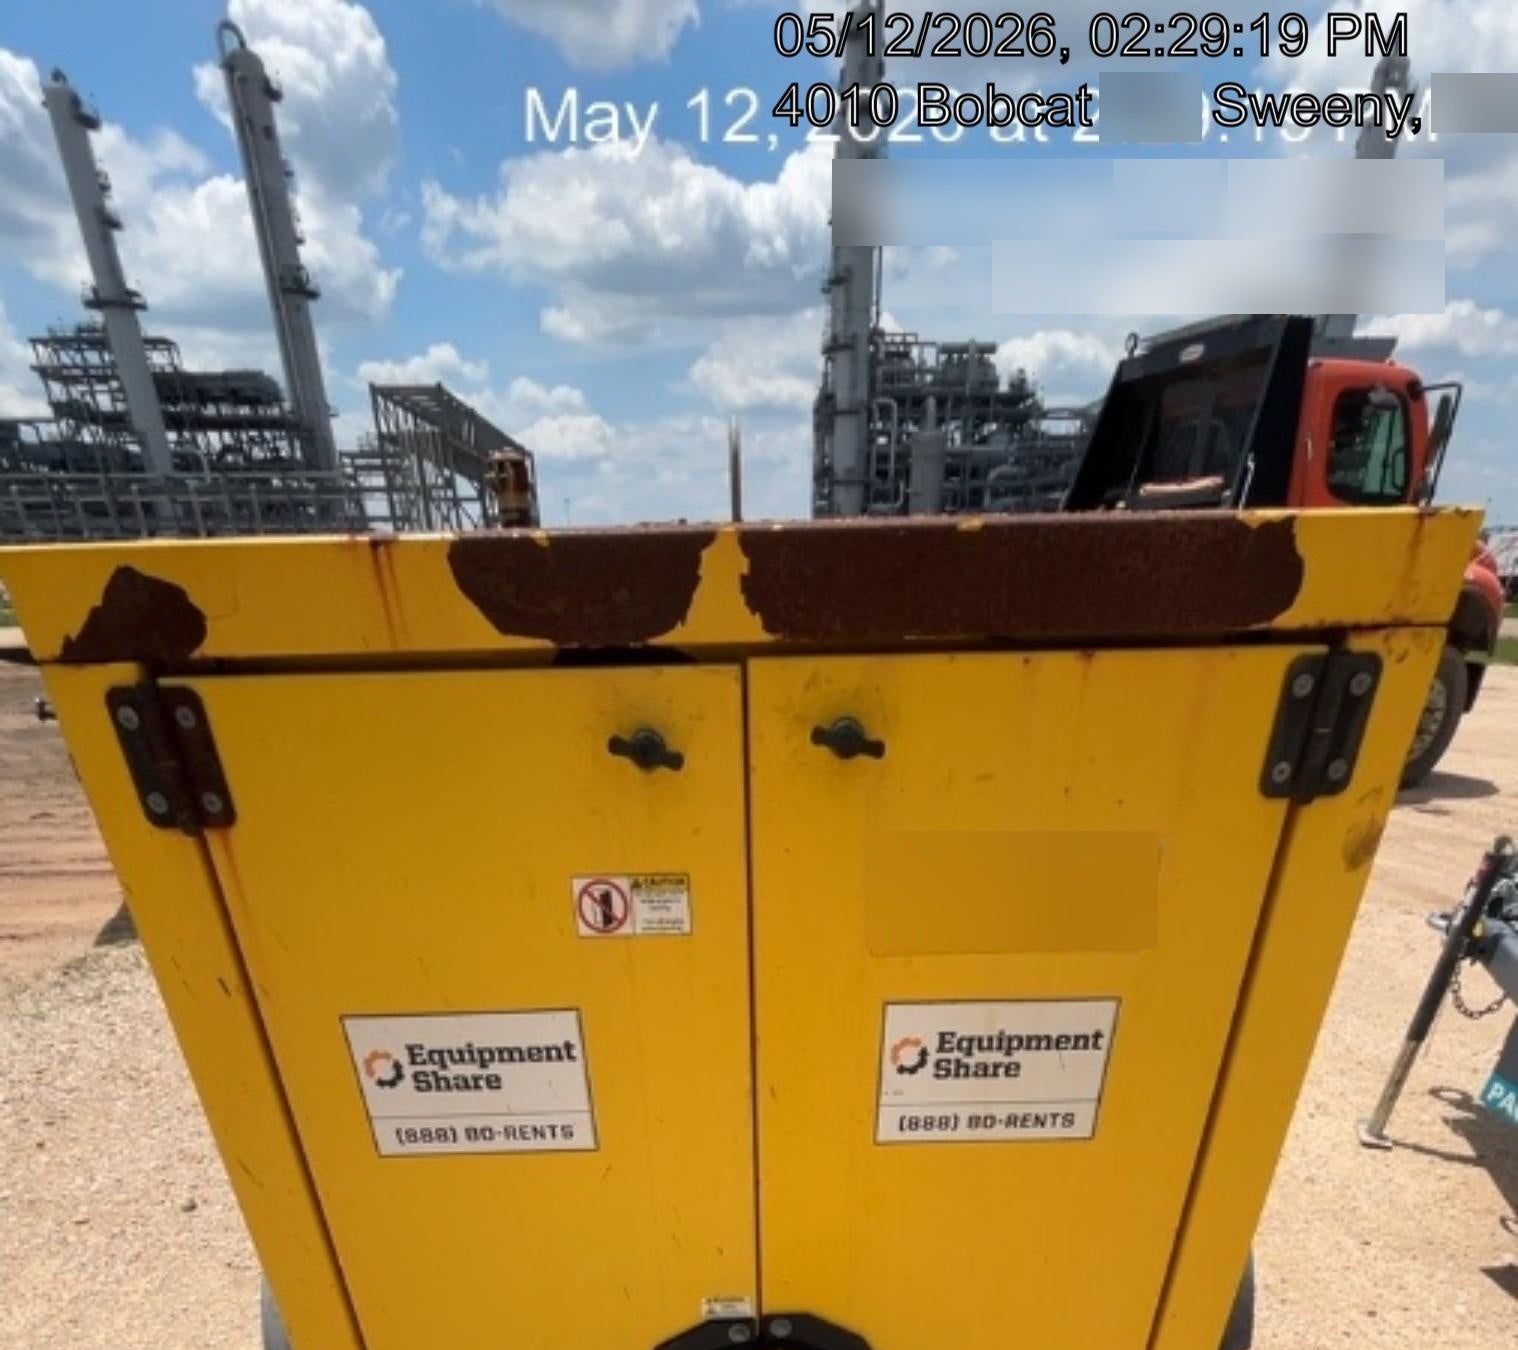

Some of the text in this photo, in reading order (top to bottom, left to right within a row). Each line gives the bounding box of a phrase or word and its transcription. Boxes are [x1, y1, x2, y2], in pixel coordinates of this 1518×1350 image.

[935, 1029, 1104, 1058] Equipment
[405, 1040, 577, 1070] Equipment
[932, 1058, 1021, 1080] Share
[411, 1070, 503, 1093] Share
[899, 1112, 961, 1132] (888)
[395, 1126, 458, 1146] (888)
